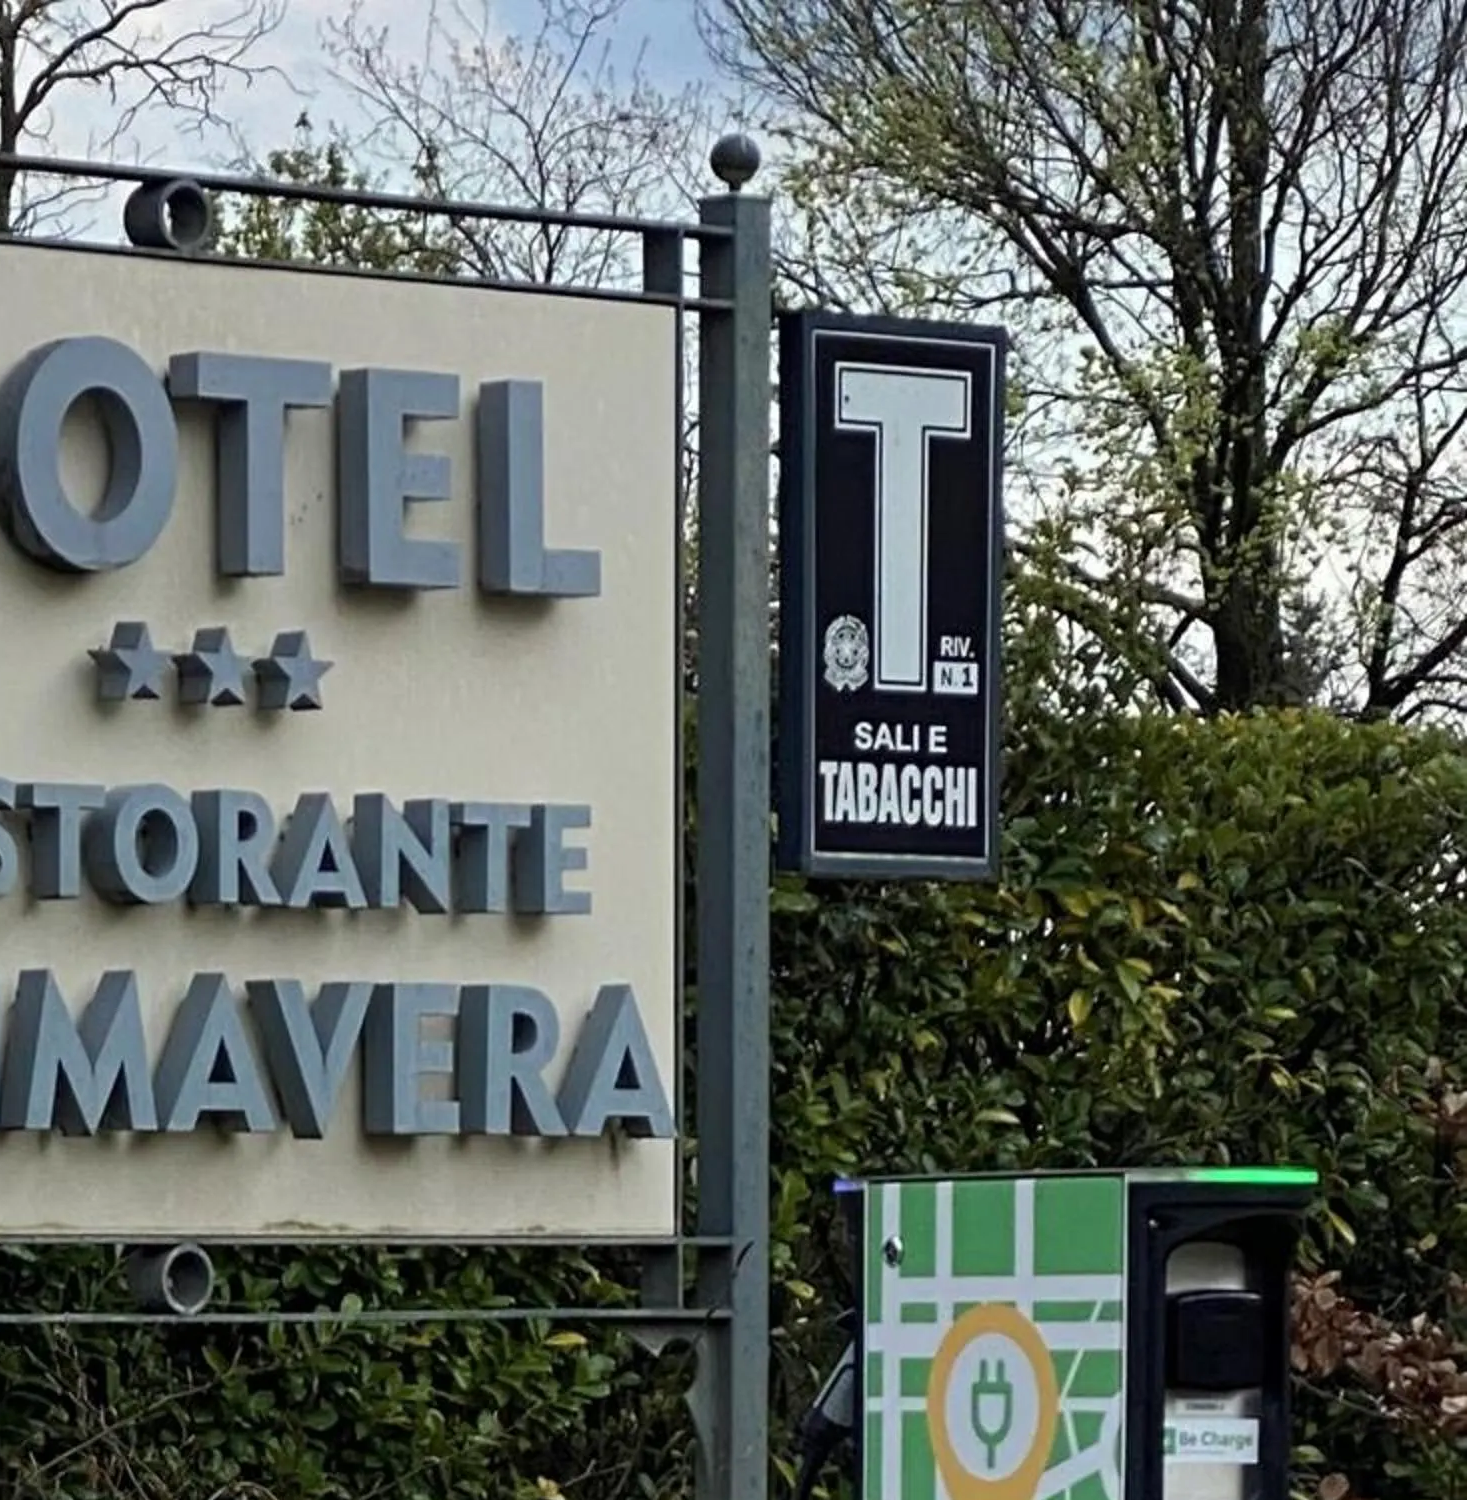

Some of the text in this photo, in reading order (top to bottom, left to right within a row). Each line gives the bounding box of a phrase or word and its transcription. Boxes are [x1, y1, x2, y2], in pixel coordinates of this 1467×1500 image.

[835, 361, 971, 690] T
[940, 635, 975, 658] RIV.
[854, 721, 948, 753] SALI E
[819, 760, 977, 827] TABACCHI
[1179, 1431, 1253, 1451] Be Charge
